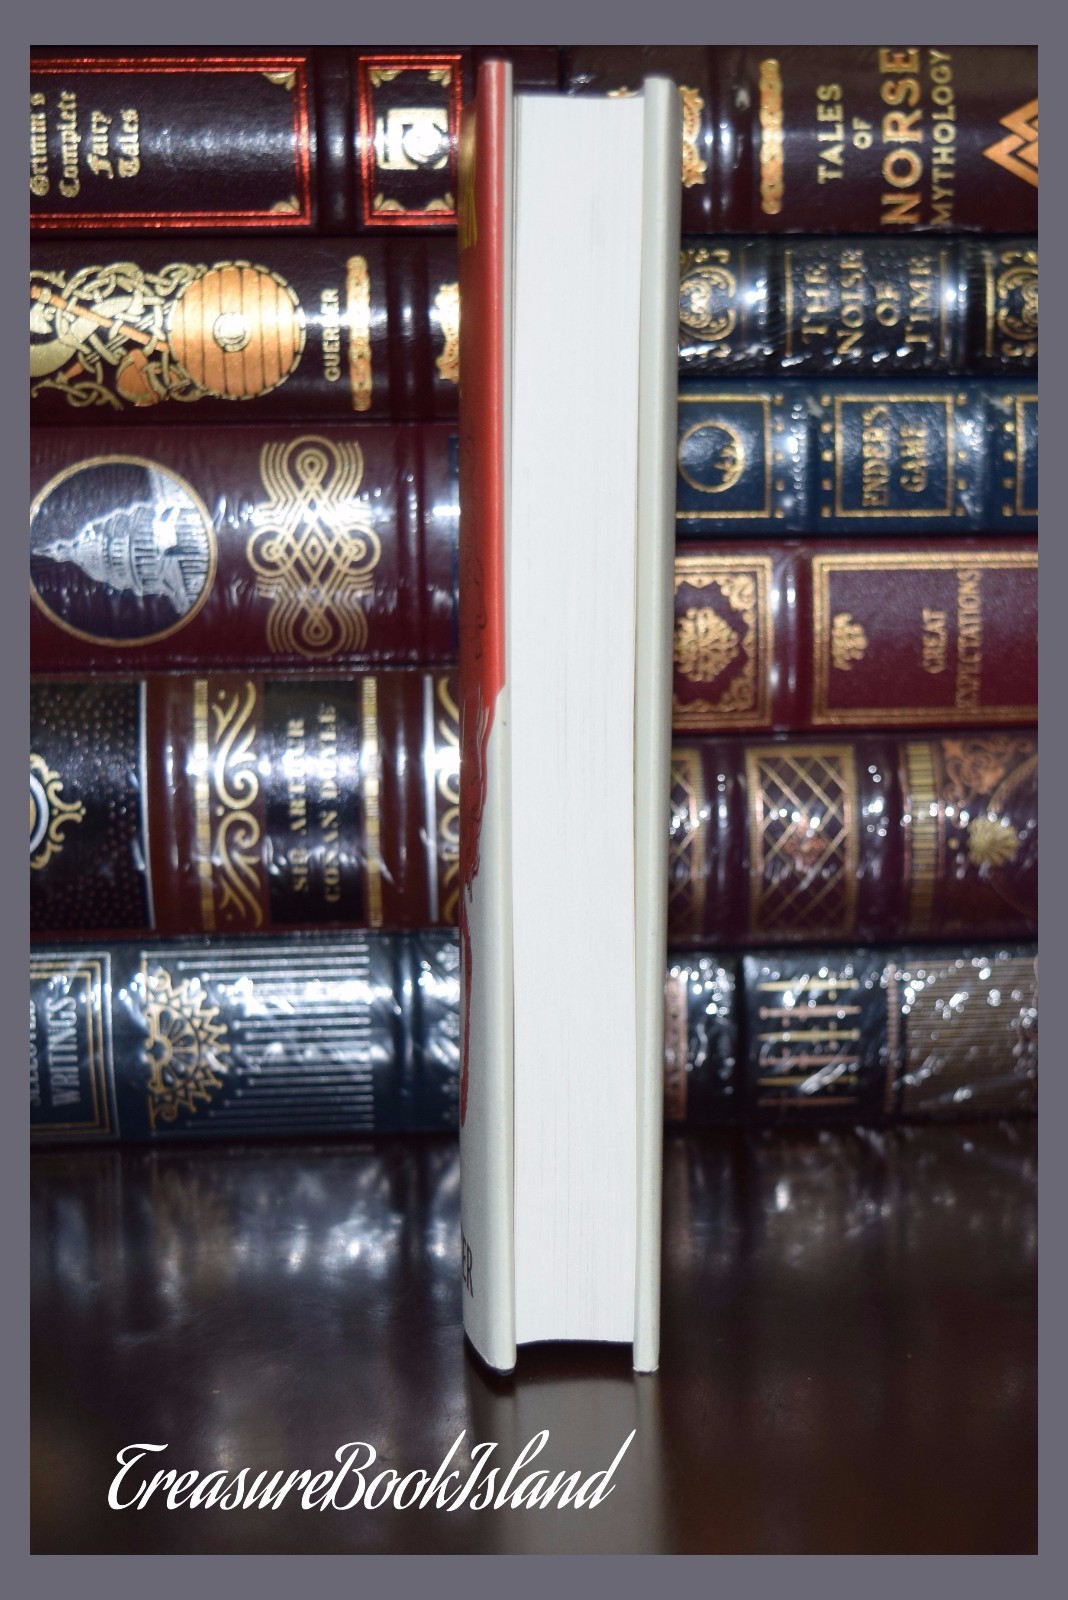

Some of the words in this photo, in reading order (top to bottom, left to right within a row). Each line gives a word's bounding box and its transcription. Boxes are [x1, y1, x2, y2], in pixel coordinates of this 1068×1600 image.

[57, 90, 81, 197] Complete
[87, 110, 114, 179] Fairy
[117, 108, 141, 178] Tales
[816, 82, 845, 185] TALES
[851, 116, 874, 149] OF
[878, 47, 924, 225] NORSE
[929, 48, 958, 226] MYTHOLOGY
[801, 262, 829, 345] THE
[835, 248, 865, 355] NOISE
[875, 281, 900, 327] OF
[904, 255, 932, 347] TIME
[921, 607, 948, 674] GREAT
[45, 996, 80, 1107] WRITINGS
